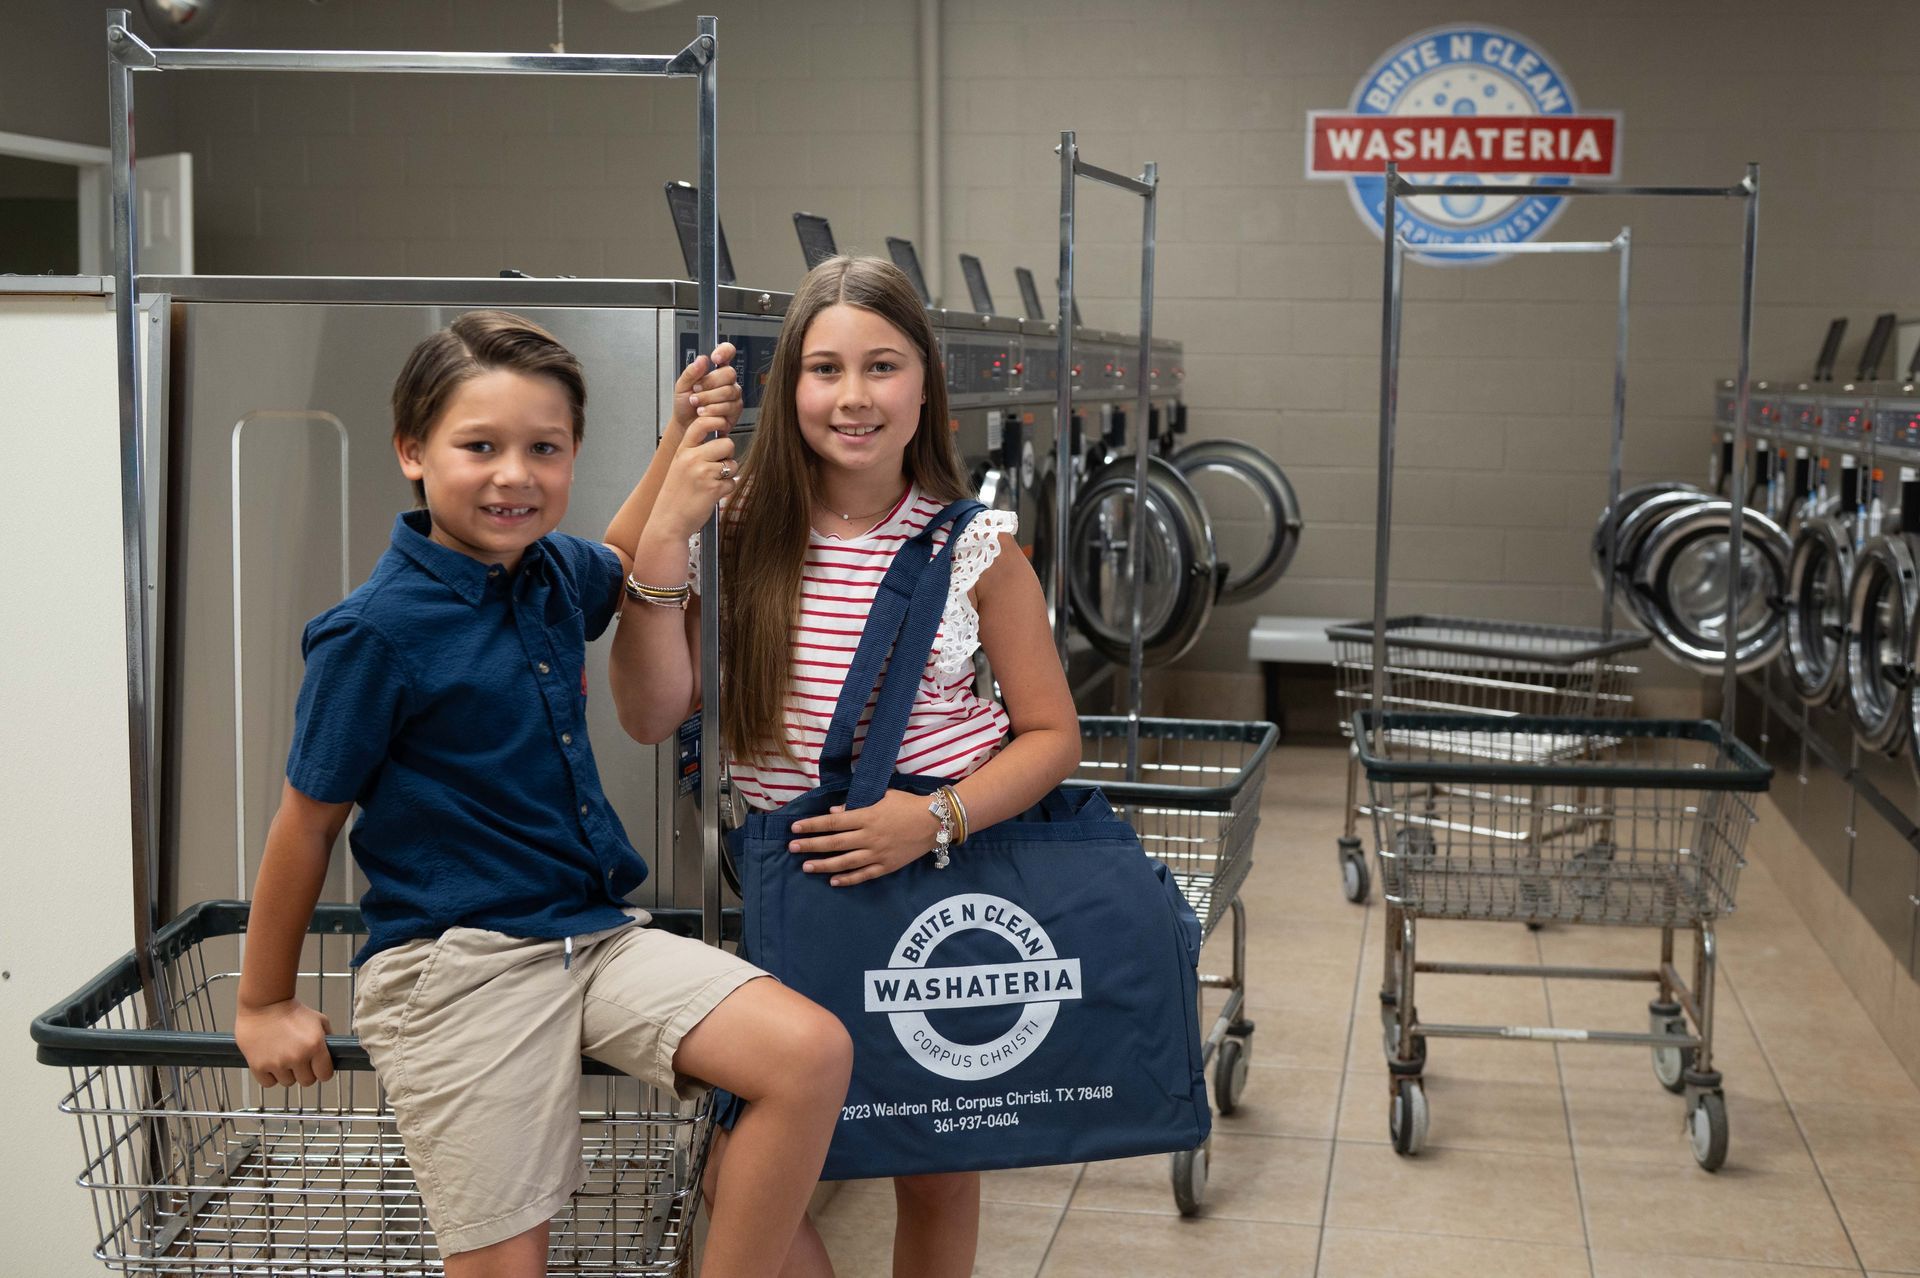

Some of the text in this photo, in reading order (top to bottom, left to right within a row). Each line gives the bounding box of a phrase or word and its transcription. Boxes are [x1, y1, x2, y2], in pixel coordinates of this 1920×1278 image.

[1365, 35, 1566, 113] BRITE N CLEAN
[1327, 128, 1602, 161] WASHATERIA
[902, 903, 1044, 963] BRITE N CLEAN
[874, 969, 1074, 1002] WASHATERIA
[913, 1020, 1039, 1068] CORPUS CHRISTI
[842, 1104, 871, 1120] 2923
[873, 1102, 928, 1117] Waldron
[932, 1098, 952, 1113] Rd.
[956, 1096, 1003, 1112] Corpus
[1055, 1088, 1075, 1102] TX
[1077, 1085, 1113, 1101] 78418
[933, 1112, 1020, 1133] 361-937-0404
